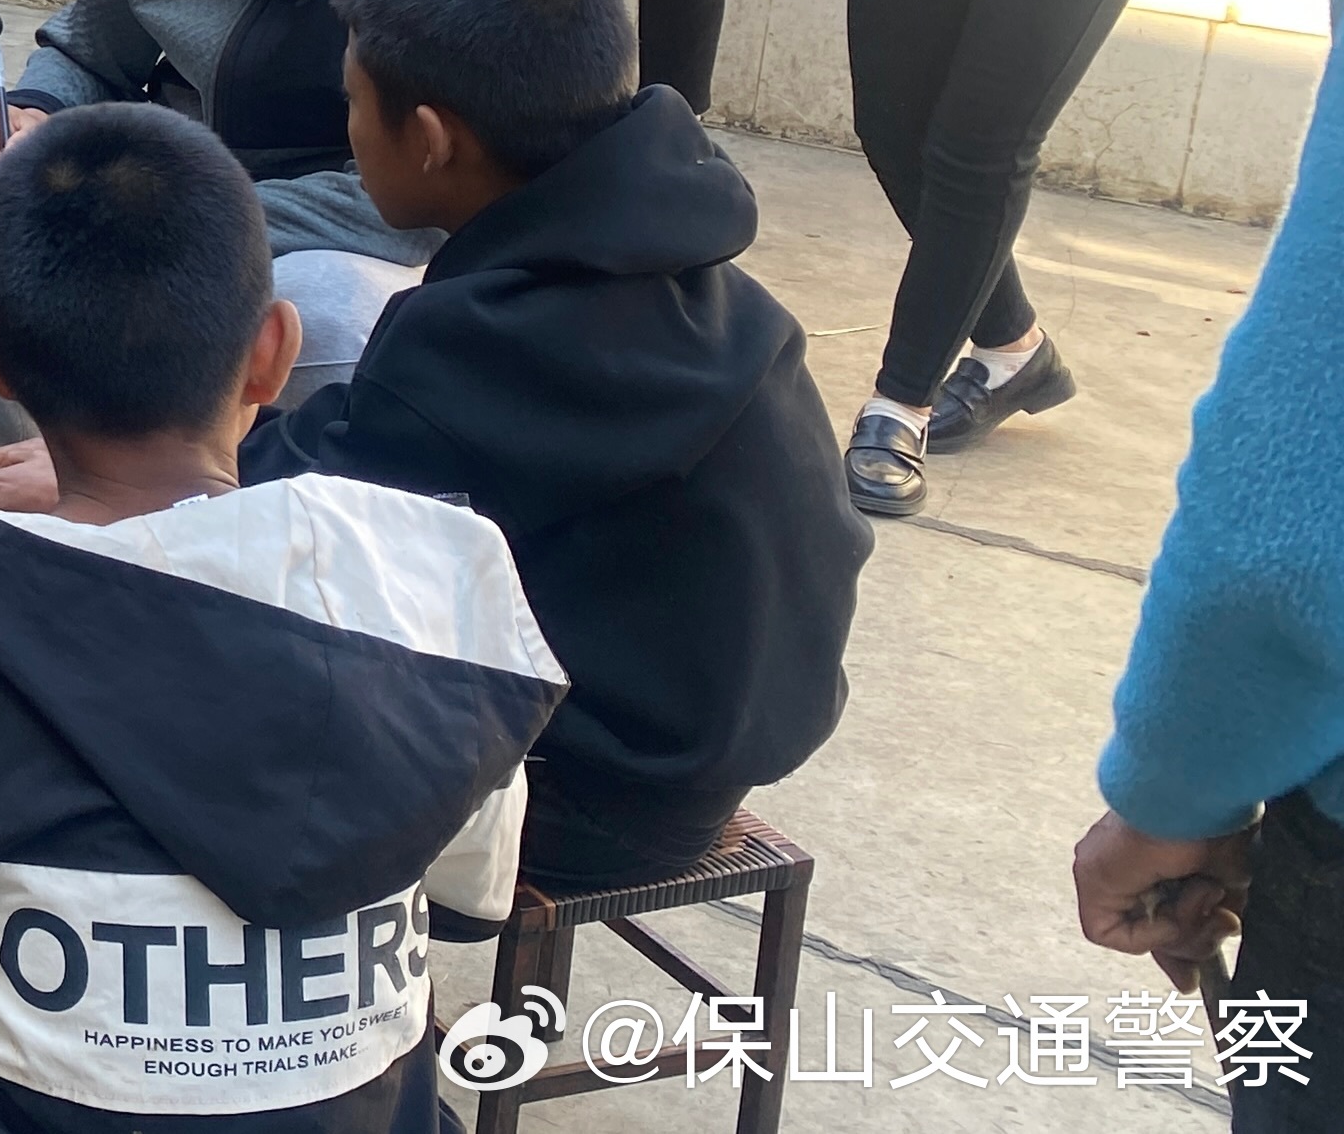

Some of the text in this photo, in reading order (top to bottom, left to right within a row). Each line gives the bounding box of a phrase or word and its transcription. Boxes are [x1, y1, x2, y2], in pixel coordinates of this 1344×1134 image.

[84, 1001, 409, 1054] HAPPINESS TO MAKE YOU SWEET
[144, 1059, 238, 1078] ENOUGH
[242, 1056, 310, 1075] TRIALS
